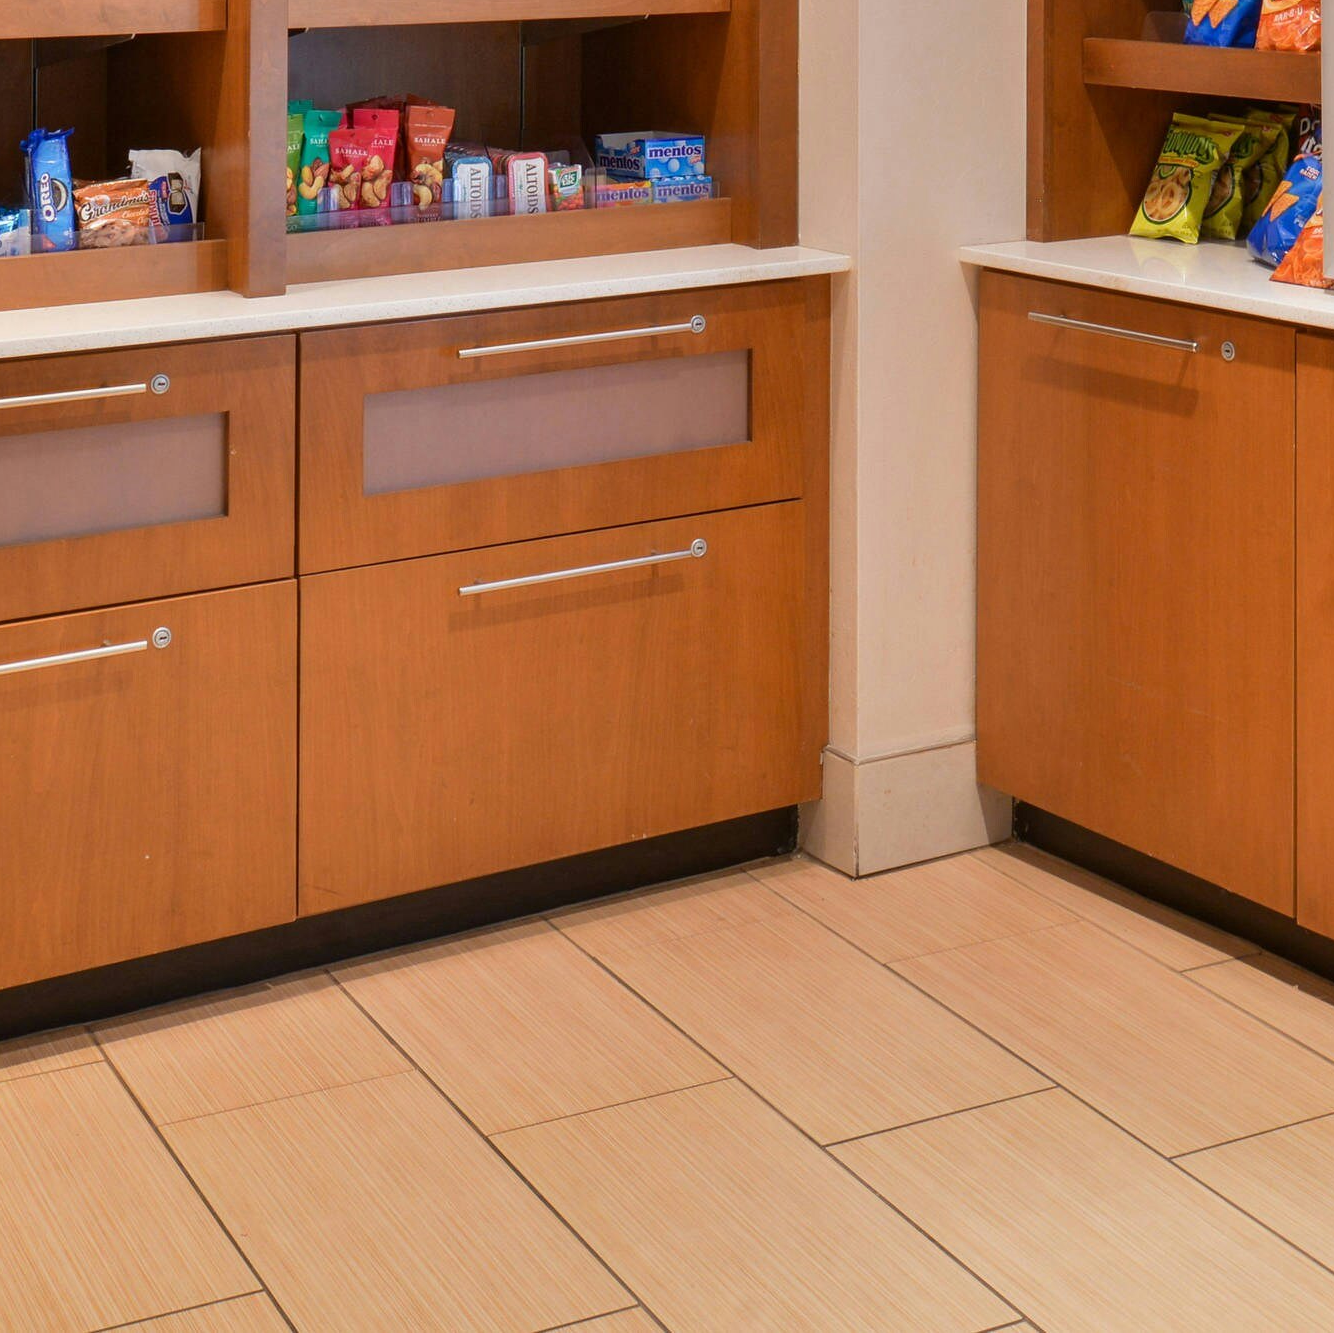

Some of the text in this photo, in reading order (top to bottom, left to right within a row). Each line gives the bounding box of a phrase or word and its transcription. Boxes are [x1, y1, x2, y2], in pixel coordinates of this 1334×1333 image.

[648, 145, 701, 159] mentos
[599, 155, 640, 171] mentos
[525, 163, 538, 215] ALTOIDS
[597, 188, 649, 202] mentos
[657, 182, 709, 197] mentos
[41, 173, 56, 221] OREO
